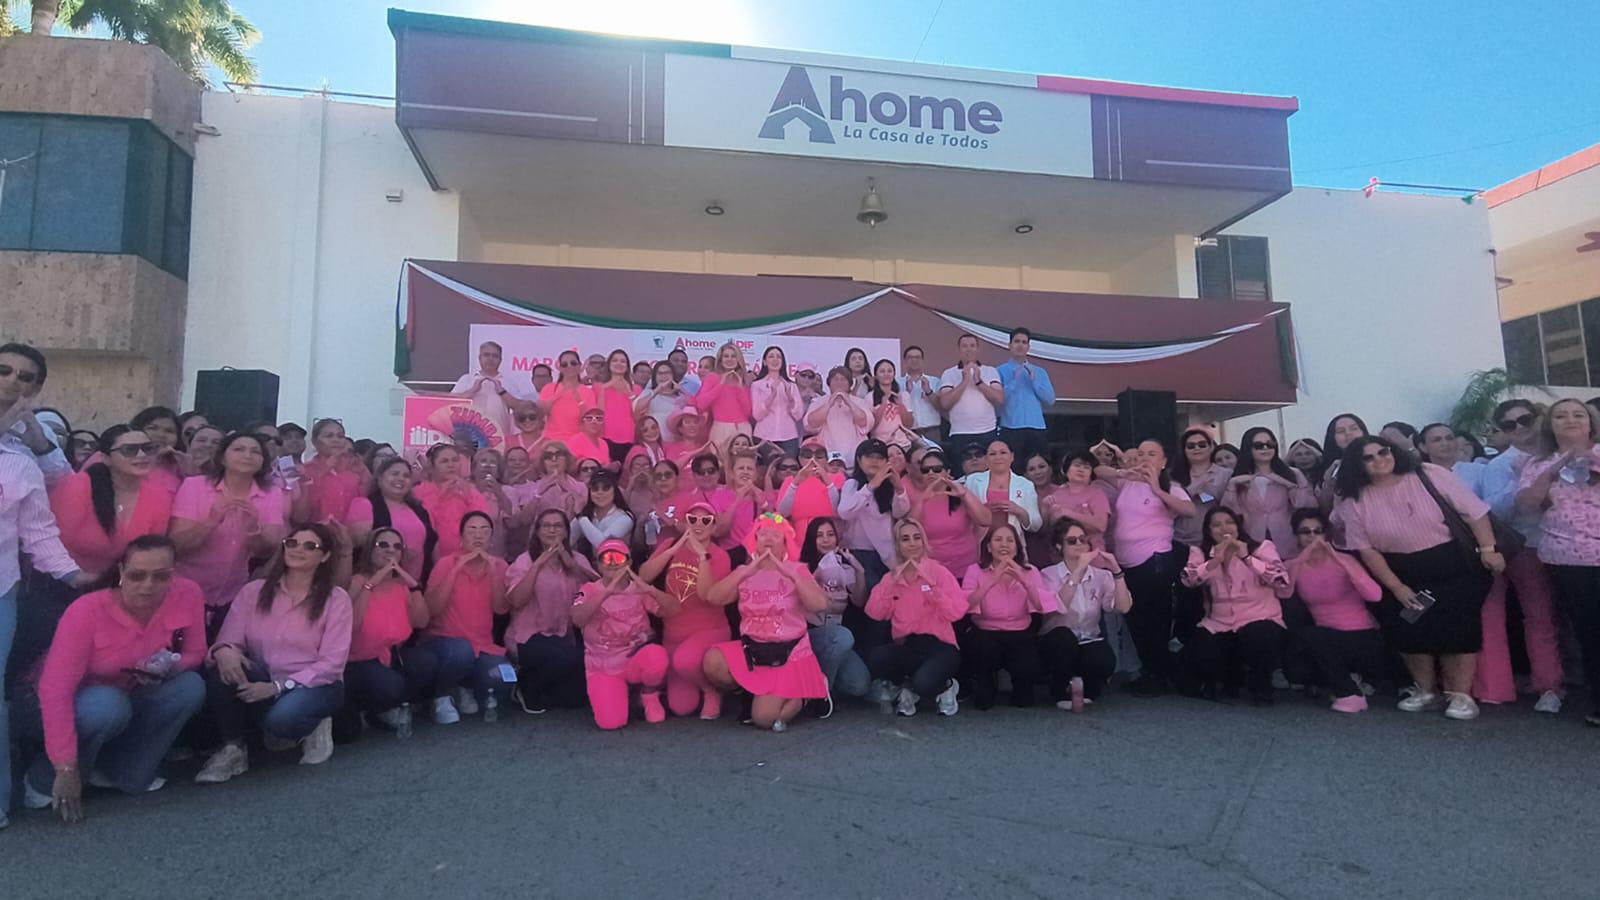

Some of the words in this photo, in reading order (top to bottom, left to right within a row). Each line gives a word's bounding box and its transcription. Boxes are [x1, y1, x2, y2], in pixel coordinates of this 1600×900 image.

[758, 66, 1003, 144] Ahome
[843, 125, 863, 139] La
[868, 127, 909, 143] Casa
[914, 131, 935, 145] de
[940, 133, 989, 149] Todos
[674, 336, 717, 351] Ahome
[735, 340, 754, 349] DIF
[450, 406, 502, 448] ZUMBA
